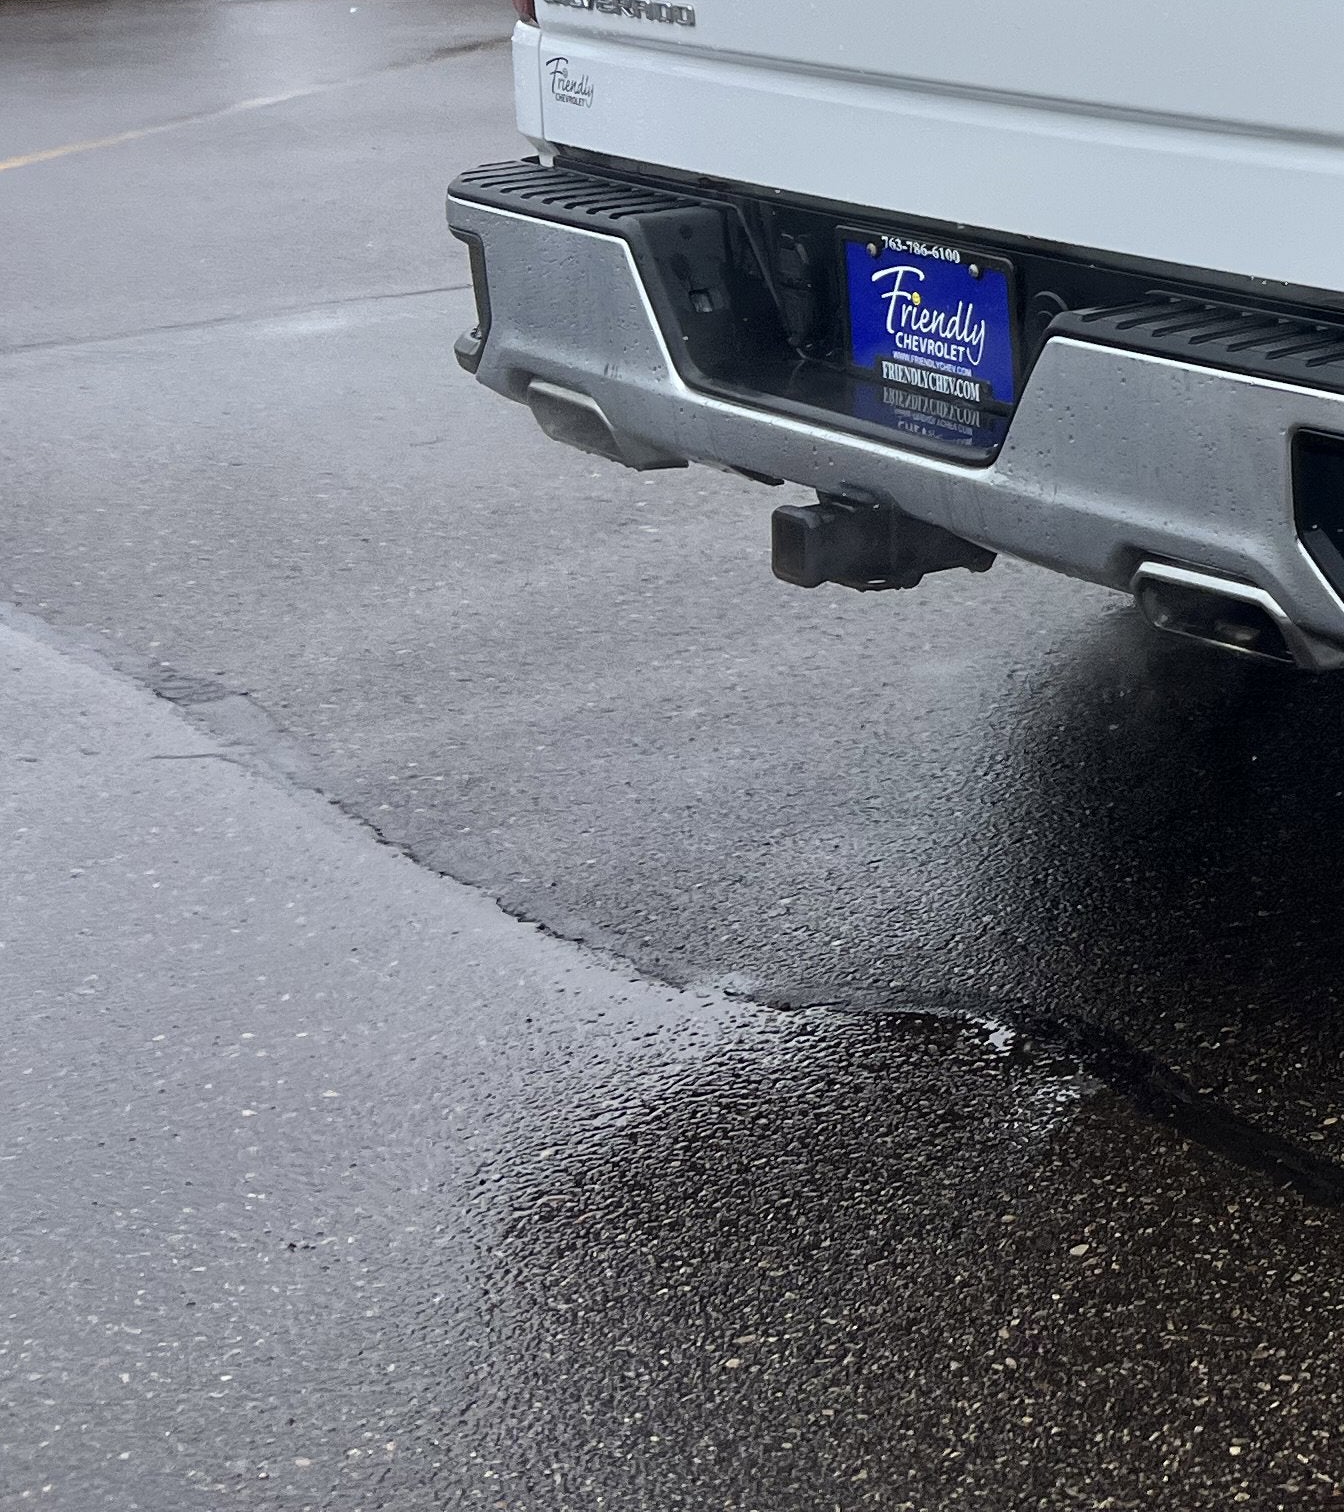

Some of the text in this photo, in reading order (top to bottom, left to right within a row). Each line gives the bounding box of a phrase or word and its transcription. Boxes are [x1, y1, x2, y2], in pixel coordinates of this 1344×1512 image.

[545, 56, 594, 109] Friendly
[881, 235, 961, 264] 763-786-6100
[871, 265, 985, 366] Friendly
[895, 331, 966, 363] CHEVROLET
[881, 360, 981, 403] FRIENDLYCHEV.COM
